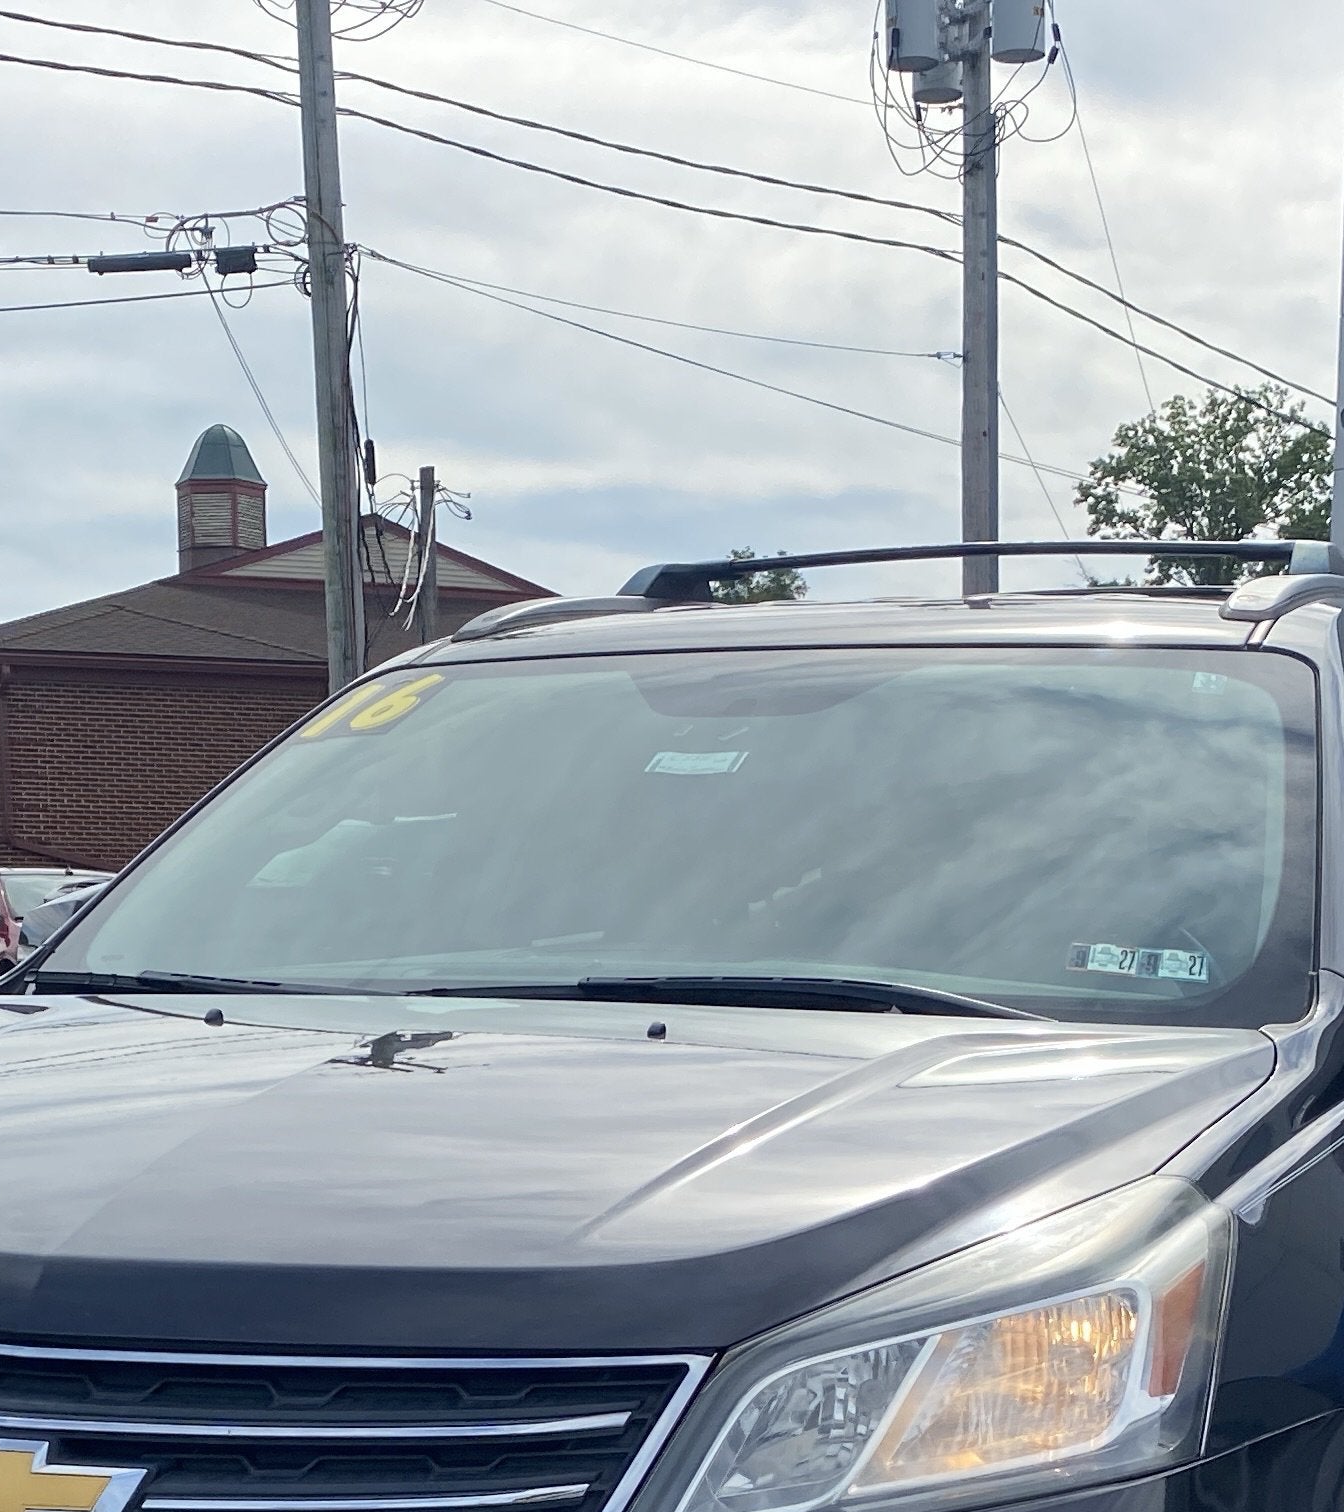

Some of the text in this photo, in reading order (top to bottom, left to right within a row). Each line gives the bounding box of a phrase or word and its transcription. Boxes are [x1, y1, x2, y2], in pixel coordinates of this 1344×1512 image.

[300, 673, 446, 738] 16
[1118, 949, 1136, 971] 27
[1188, 955, 1205, 977] 27
